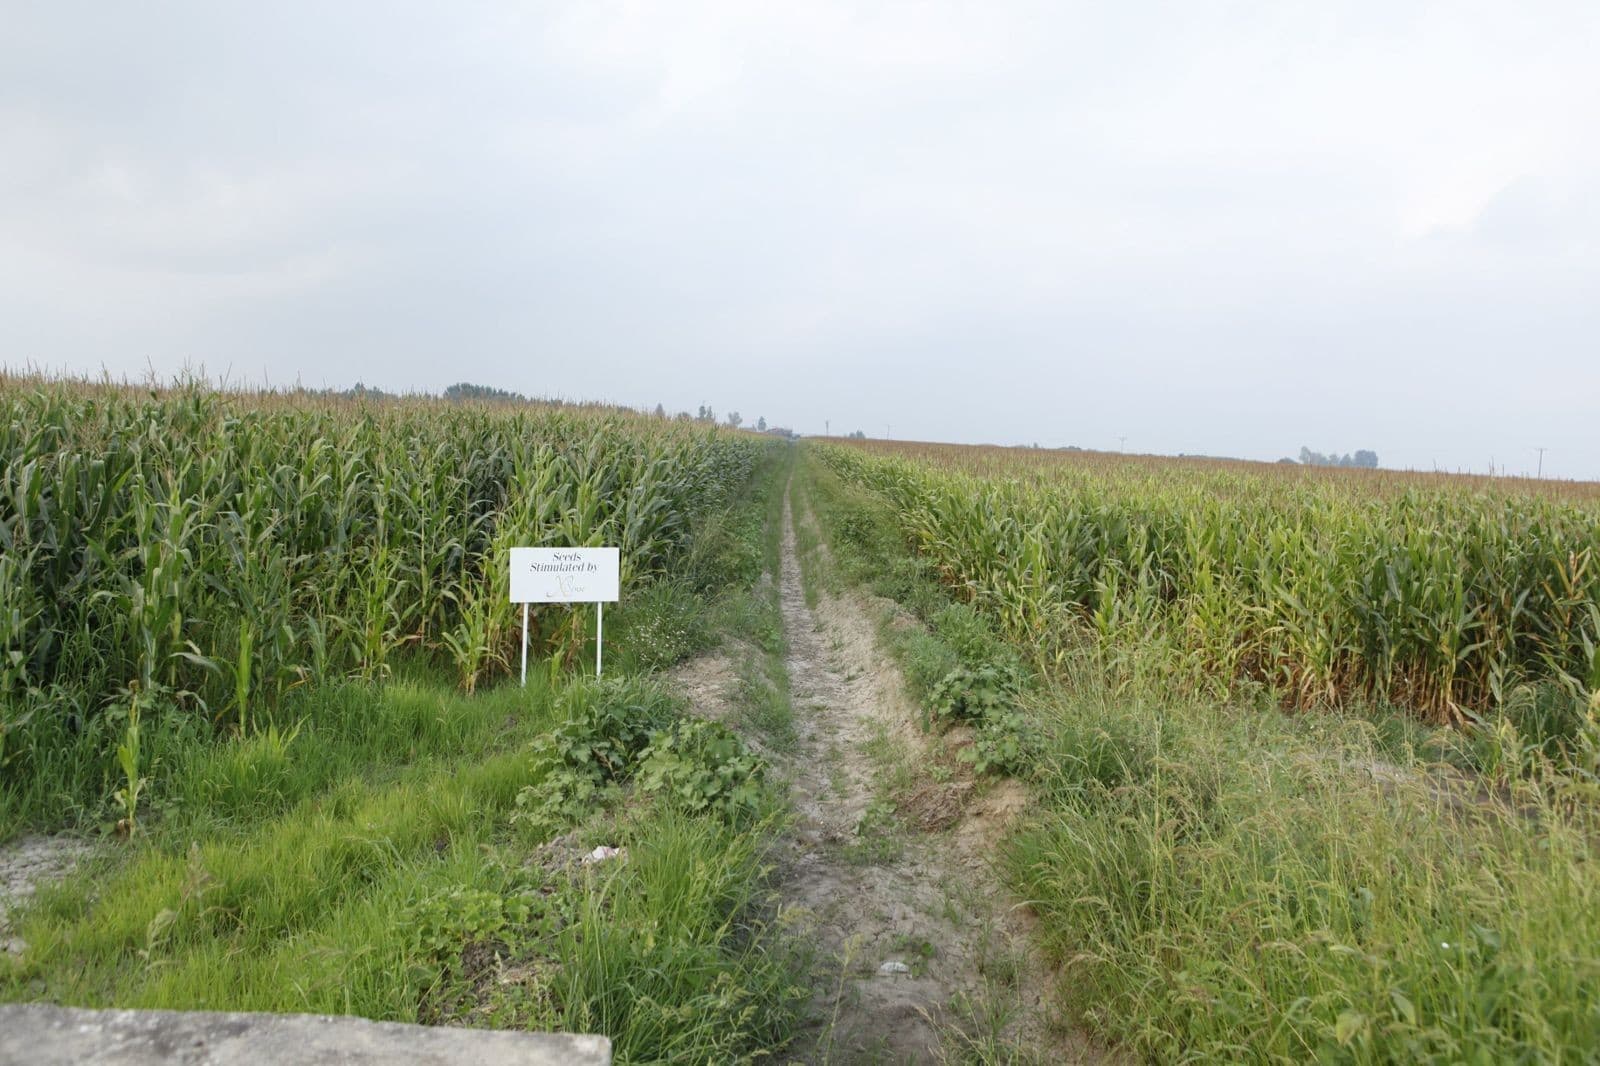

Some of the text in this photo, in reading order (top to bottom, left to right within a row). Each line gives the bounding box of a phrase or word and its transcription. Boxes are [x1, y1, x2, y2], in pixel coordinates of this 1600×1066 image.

[552, 551, 582, 562] Seeds
[529, 562, 598, 574] Stimulated by
